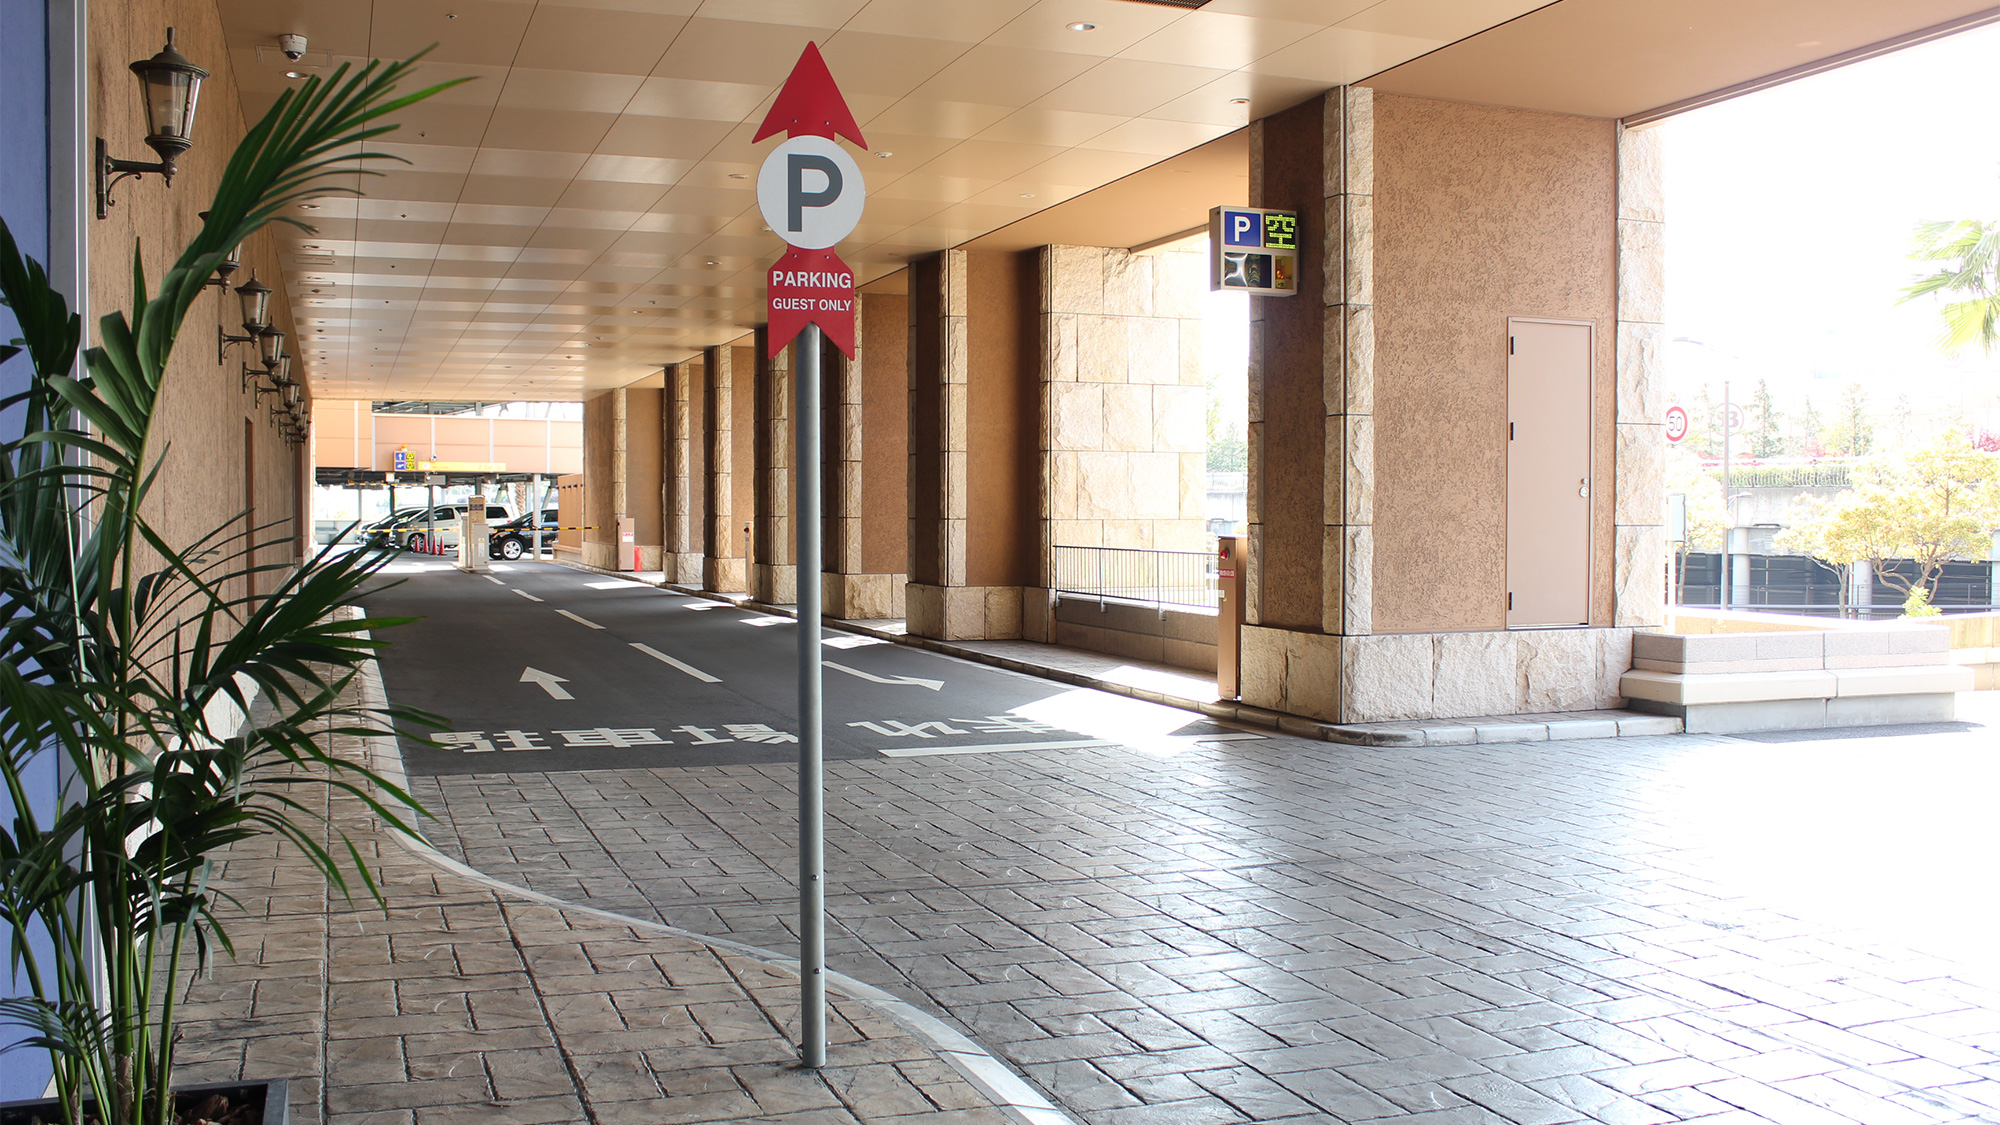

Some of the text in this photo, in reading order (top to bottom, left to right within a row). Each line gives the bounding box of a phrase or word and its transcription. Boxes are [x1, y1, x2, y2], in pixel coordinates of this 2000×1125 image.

[787, 154, 843, 232] P
[1235, 216, 1251, 242] P
[1265, 214, 1296, 249] 空
[773, 270, 852, 289] PARKING
[772, 298, 852, 312] GUEST ONLY
[1668, 416, 1683, 432] 50
[429, 723, 798, 753] 駐車場
